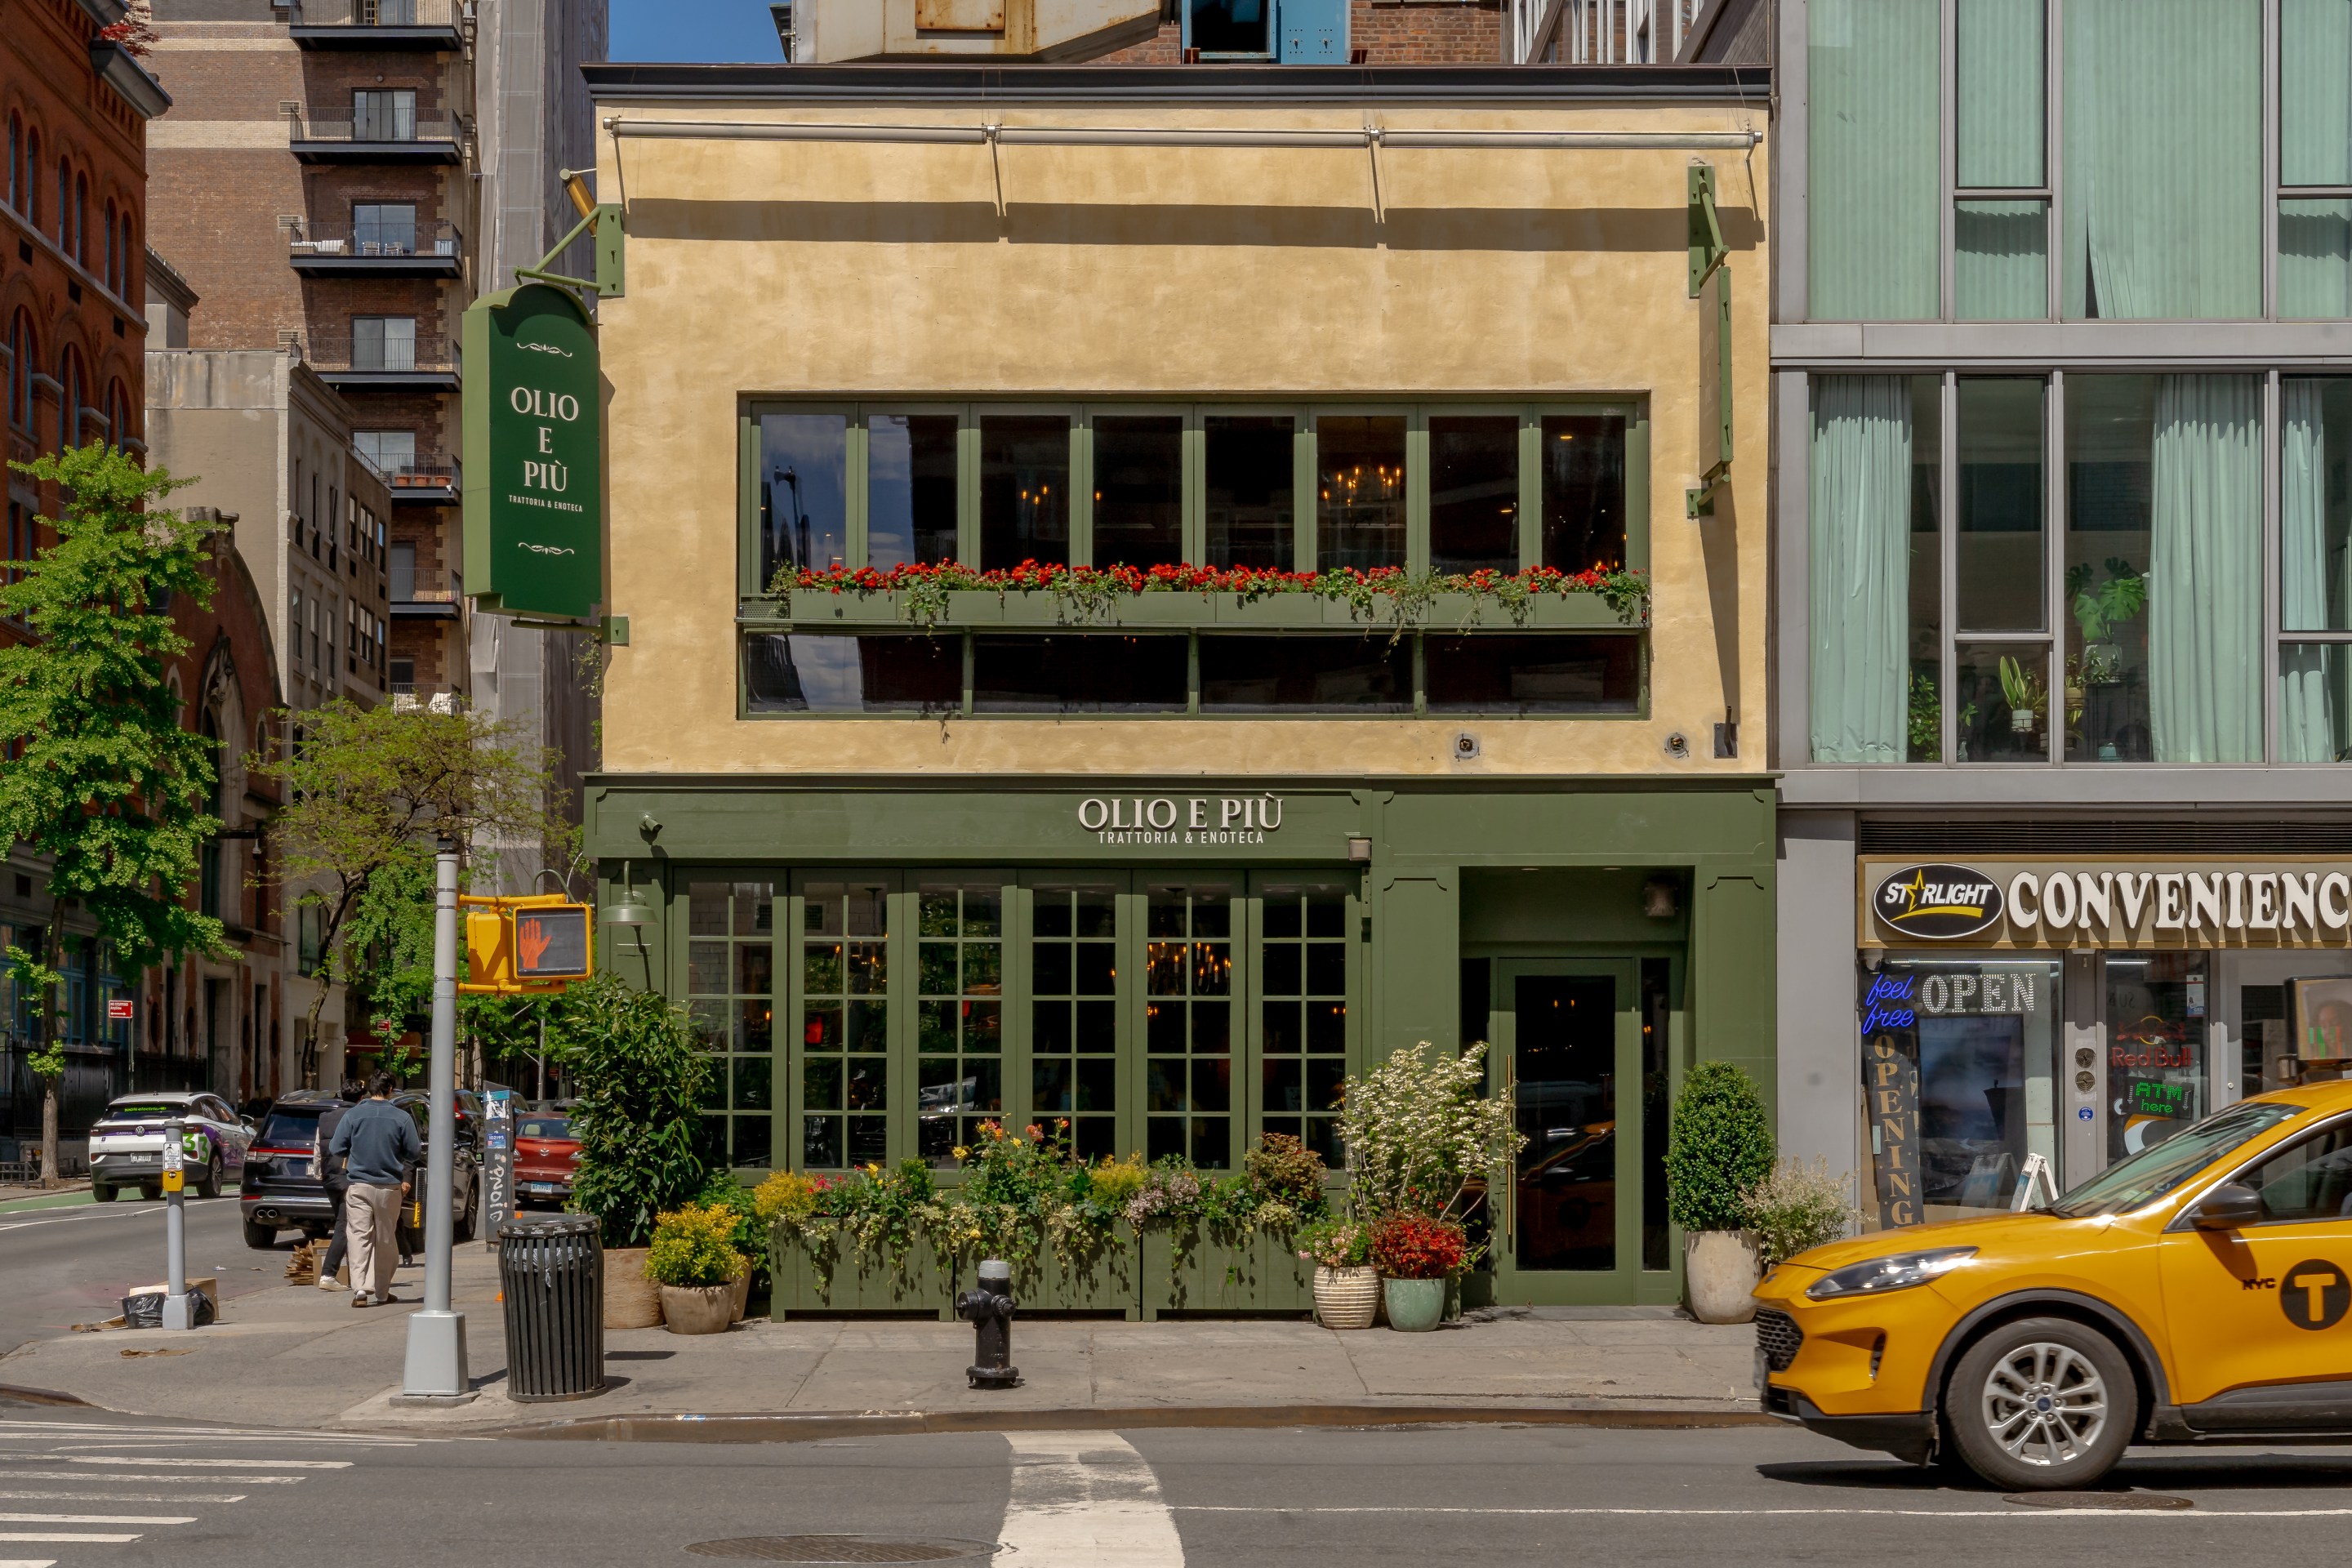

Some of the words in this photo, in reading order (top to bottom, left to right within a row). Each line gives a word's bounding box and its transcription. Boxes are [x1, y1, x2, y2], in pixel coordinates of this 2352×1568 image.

[510, 386, 579, 421] OLIO
[538, 426, 553, 454] E
[523, 459, 568, 492] PIÙ
[509, 495, 546, 507] TRATTORIA
[547, 500, 552, 508] &
[554, 501, 583, 513] ENOTECA
[1078, 798, 1178, 830] OLIO
[1188, 798, 1209, 829] E
[1220, 791, 1284, 830] PIÙ
[1098, 831, 1178, 844] TRATTORIA
[1184, 831, 1193, 844] &
[1200, 831, 1264, 844] ENOTECA
[1865, 974, 1913, 1006] feel
[1922, 973, 2036, 1013] OPEN
[1862, 1003, 1914, 1035] free
[2112, 1047, 2150, 1067] Red
[2155, 1047, 2191, 1067] Bull
[2136, 1082, 2182, 1101] ATM
[2140, 1098, 2173, 1113] here
[1874, 1035, 1913, 1225] OPENING
[2243, 1277, 2275, 1290] NYC
[2294, 1273, 2336, 1321] T
